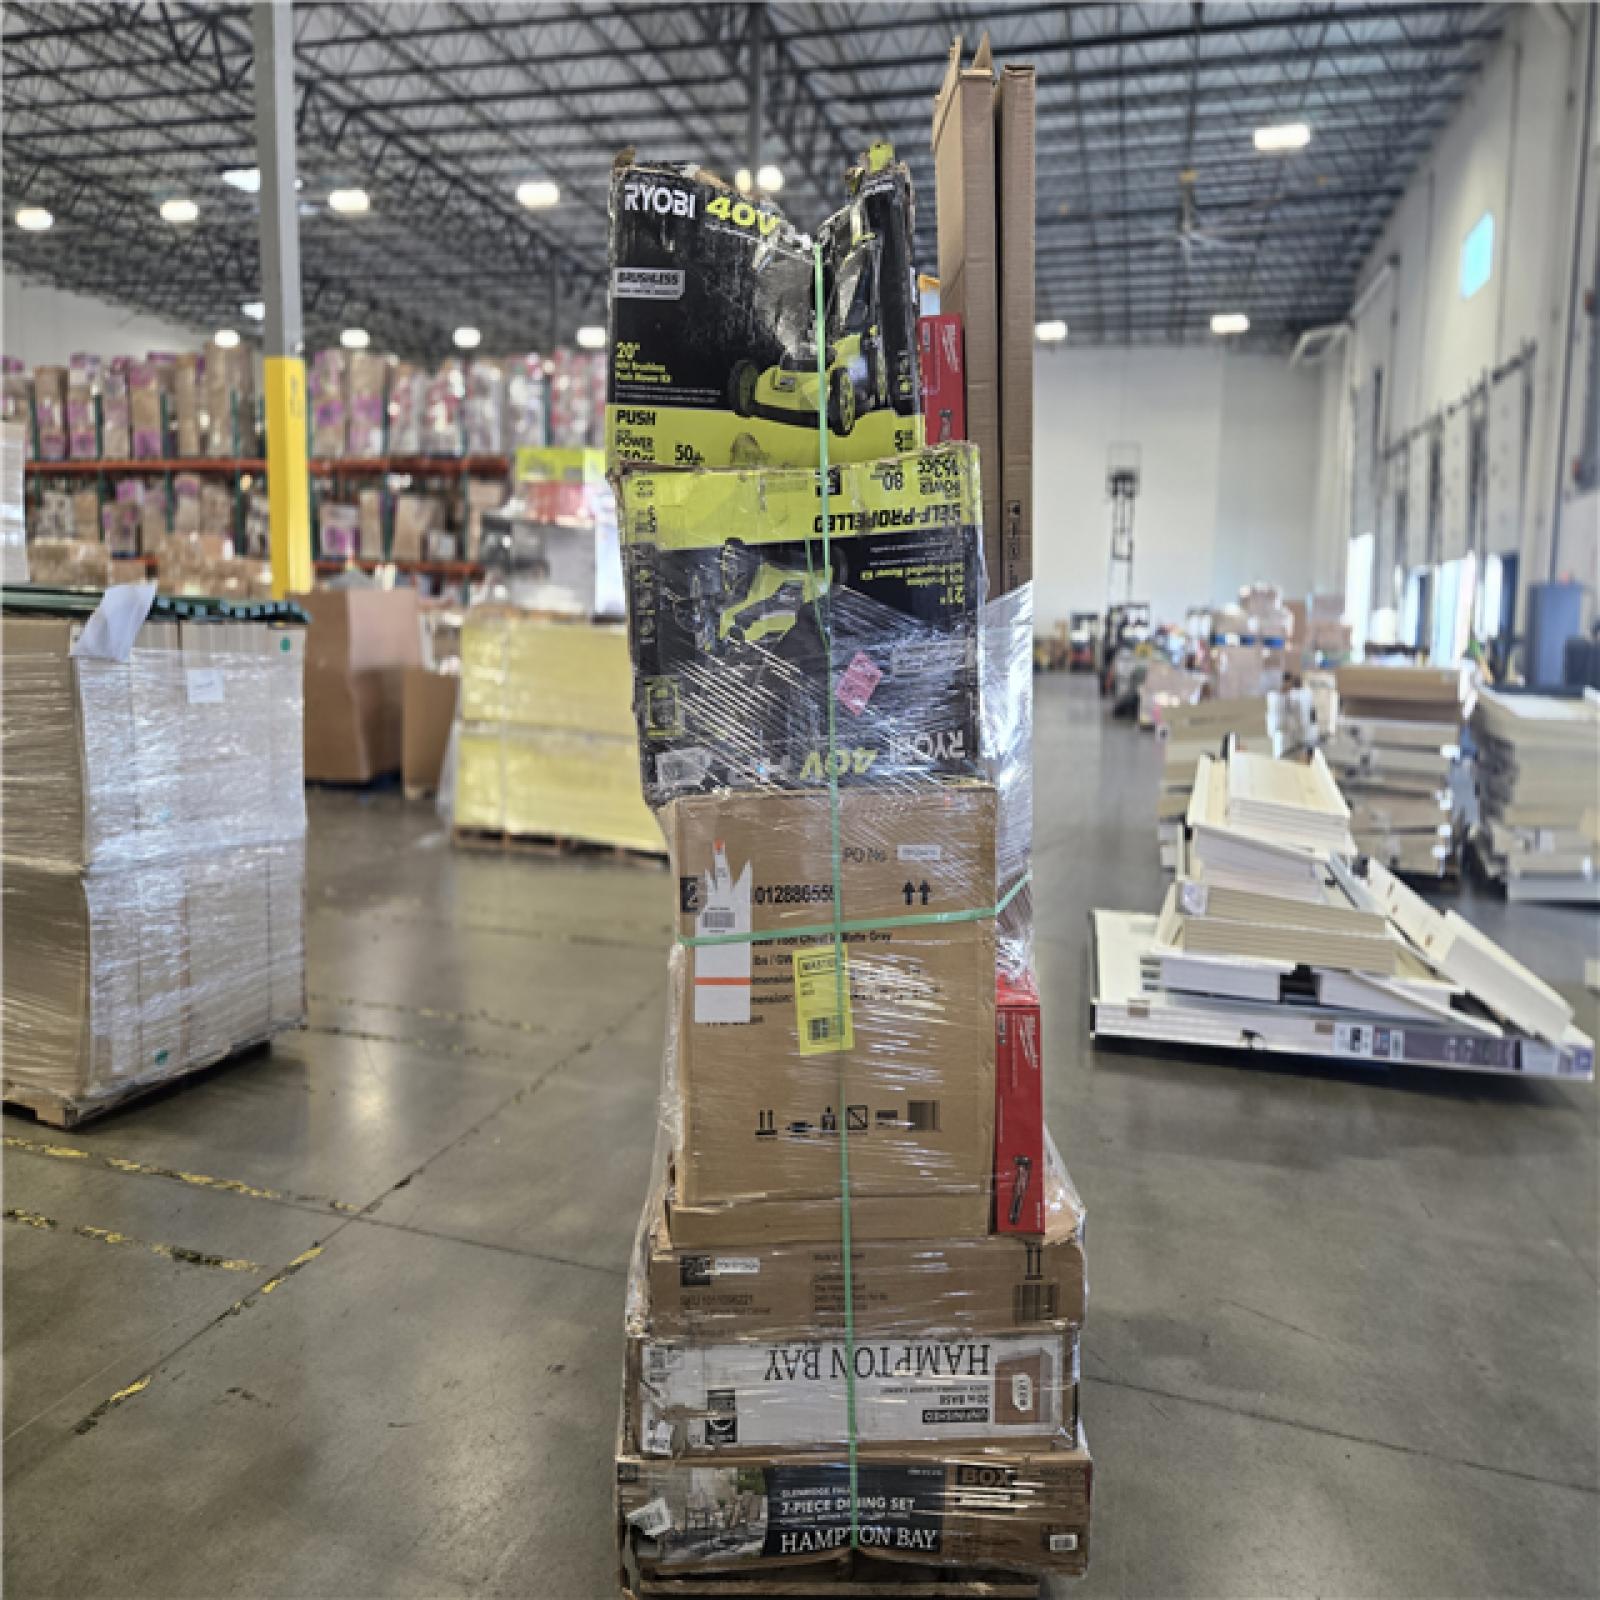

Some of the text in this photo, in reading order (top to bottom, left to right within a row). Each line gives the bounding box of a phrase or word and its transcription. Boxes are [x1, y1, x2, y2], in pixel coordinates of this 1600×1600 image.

[624, 184, 781, 237] RYOBI 40V
[616, 409, 656, 426] PUSH
[763, 1341, 990, 1381] HAMPTON BAY
[963, 1466, 1013, 1484] BOX
[890, 1496, 916, 1511] SET
[897, 1526, 938, 1549] BAY
